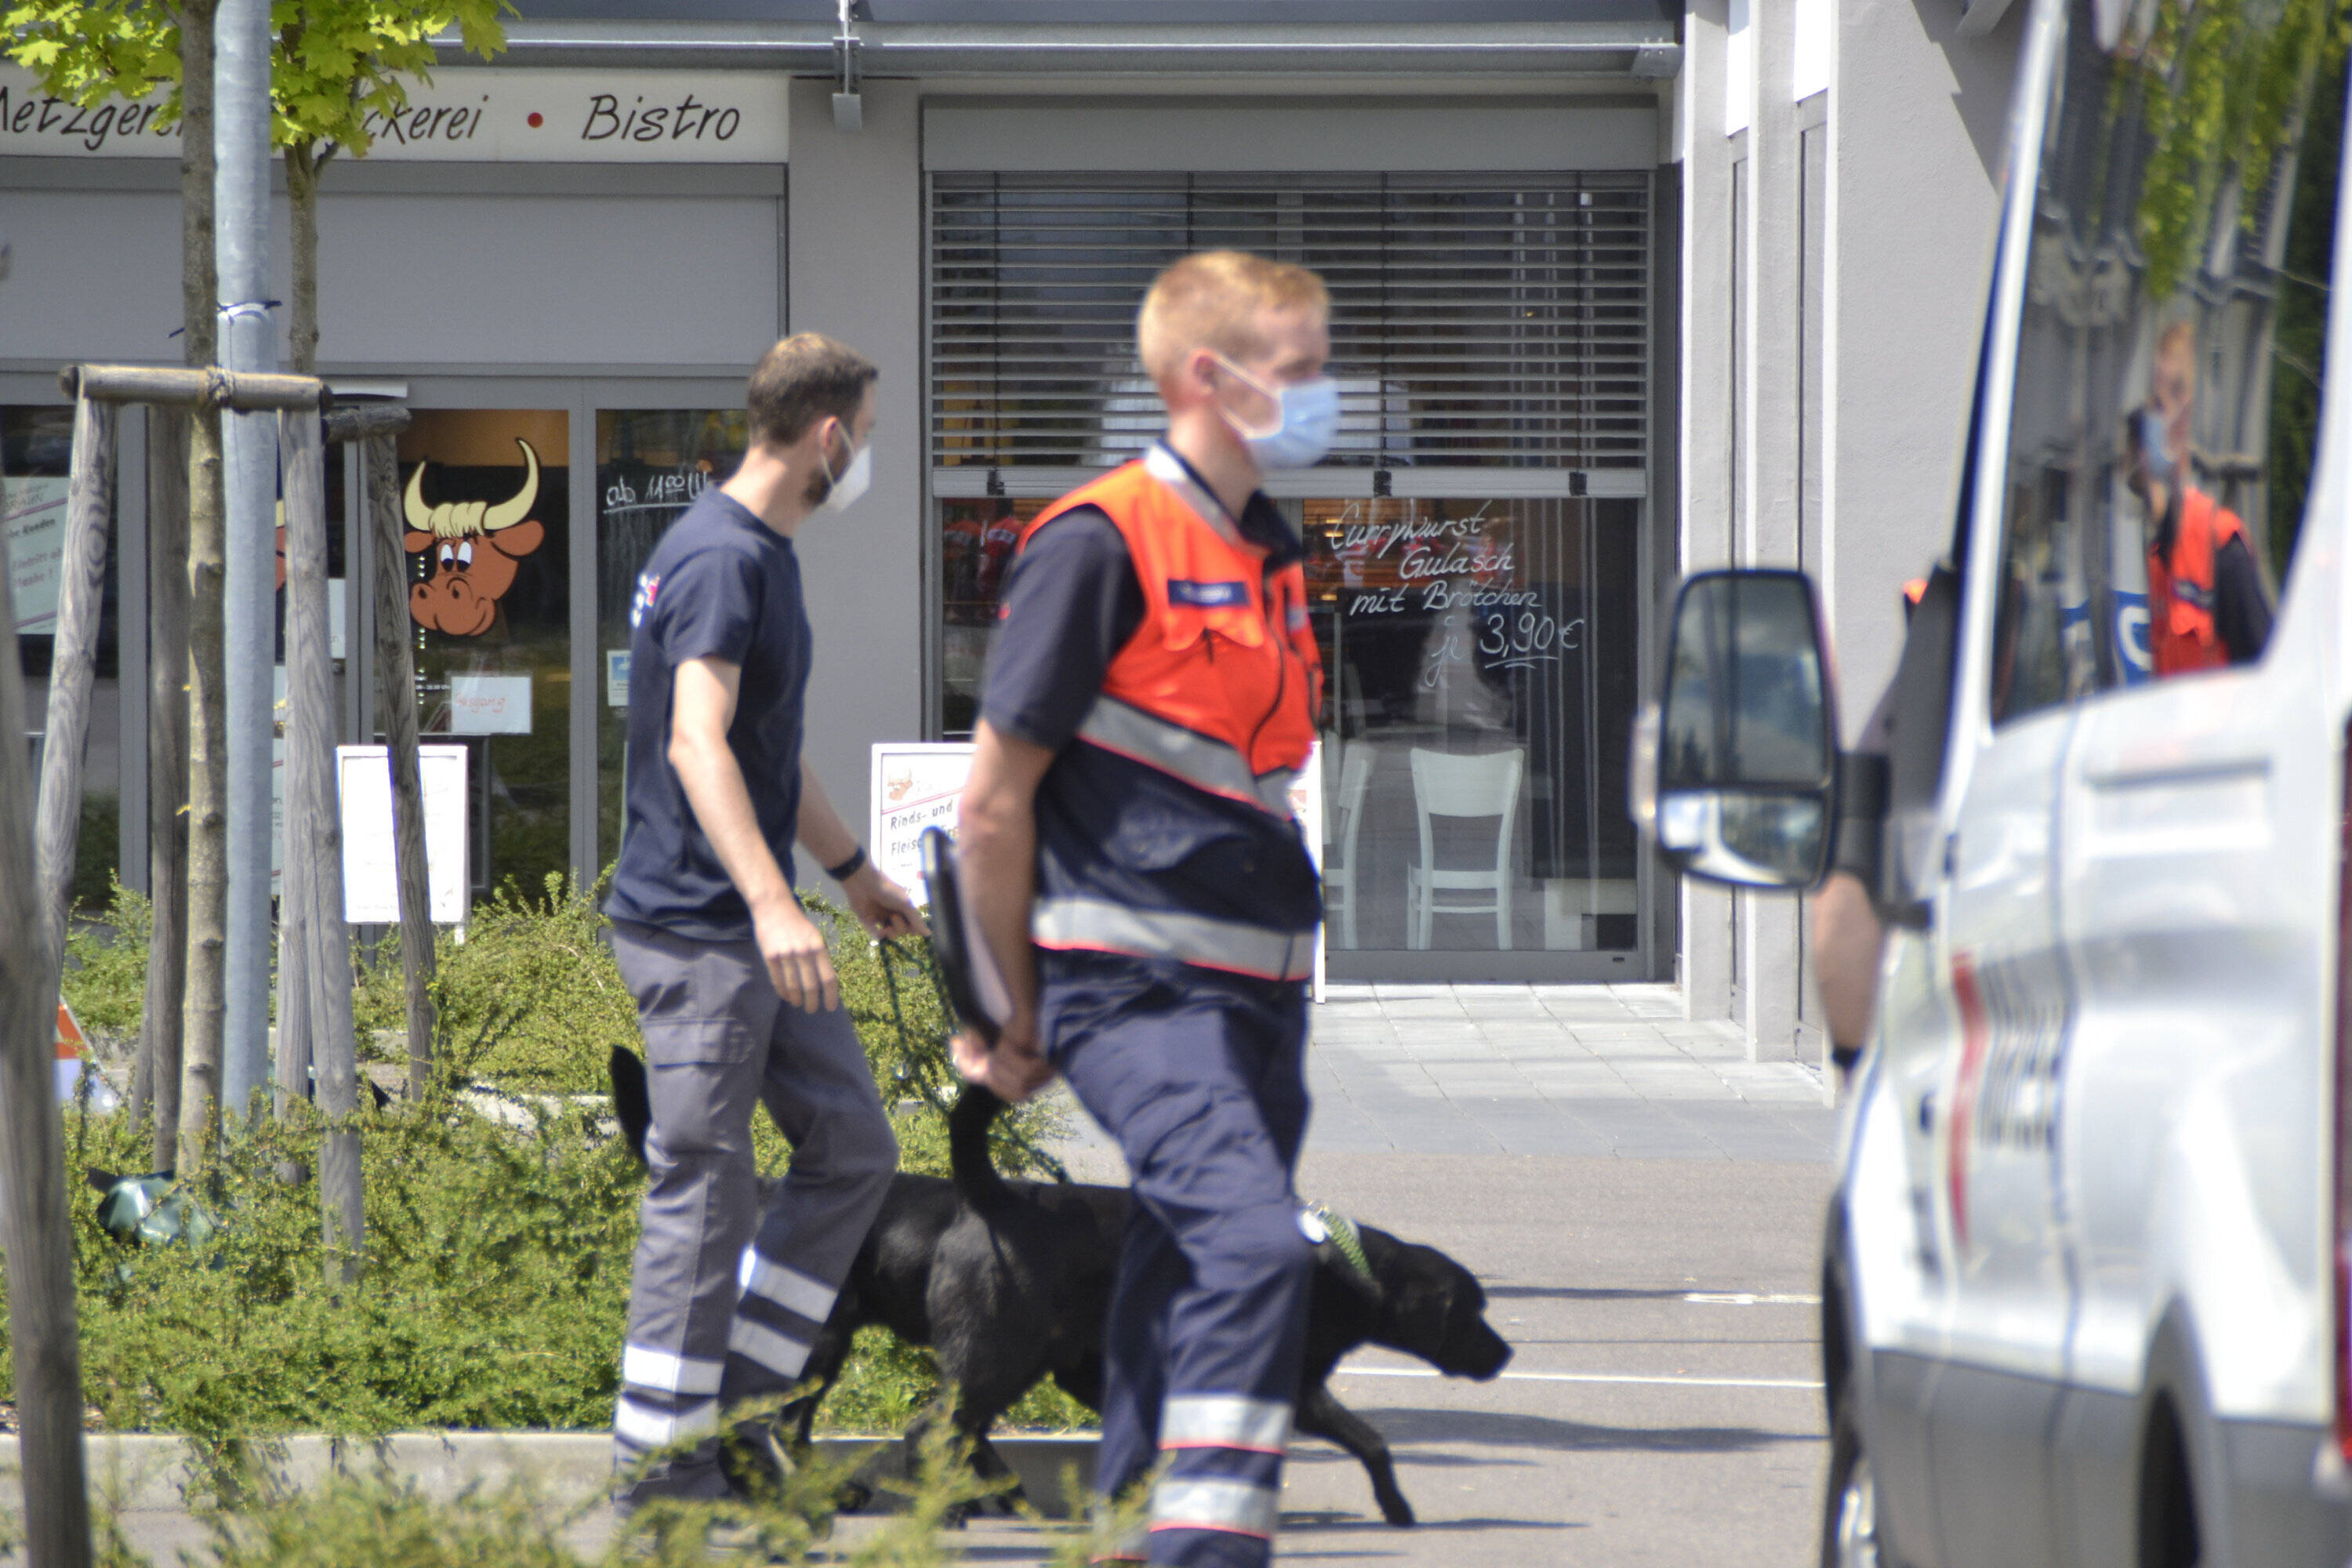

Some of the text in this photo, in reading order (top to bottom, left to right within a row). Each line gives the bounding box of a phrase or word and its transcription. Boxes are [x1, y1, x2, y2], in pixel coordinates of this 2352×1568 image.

[581, 94, 740, 142] Bistro
[606, 474, 636, 506] ab
[1399, 541, 1515, 580] Gulasch
[1348, 577, 1543, 617] mit Brötchen
[890, 798, 953, 831] Rinds- und
